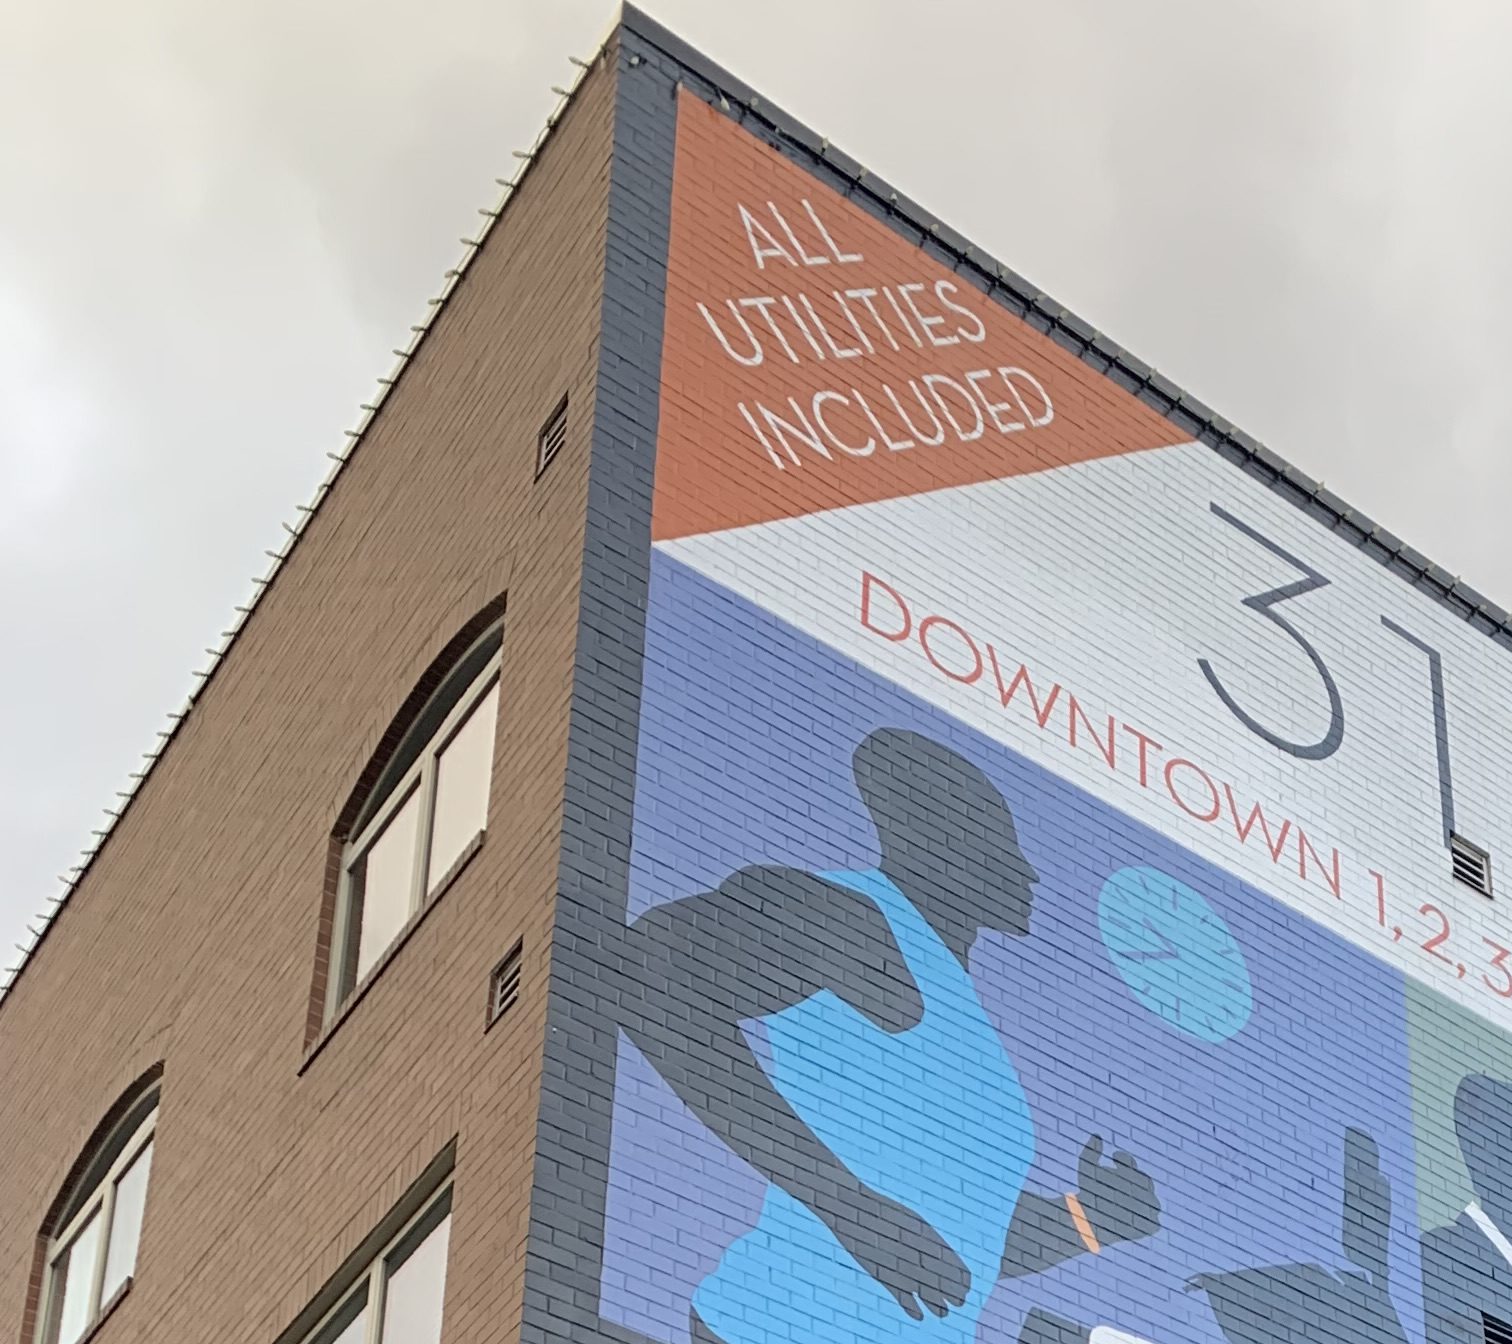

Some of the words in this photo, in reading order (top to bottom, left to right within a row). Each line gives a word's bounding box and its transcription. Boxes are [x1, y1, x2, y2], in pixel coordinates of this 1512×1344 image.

[737, 199, 863, 269] ALL
[696, 280, 986, 366] UTILITIES
[737, 367, 1055, 470] INCLUDED
[860, 570, 1341, 900] DOWNTOWN
